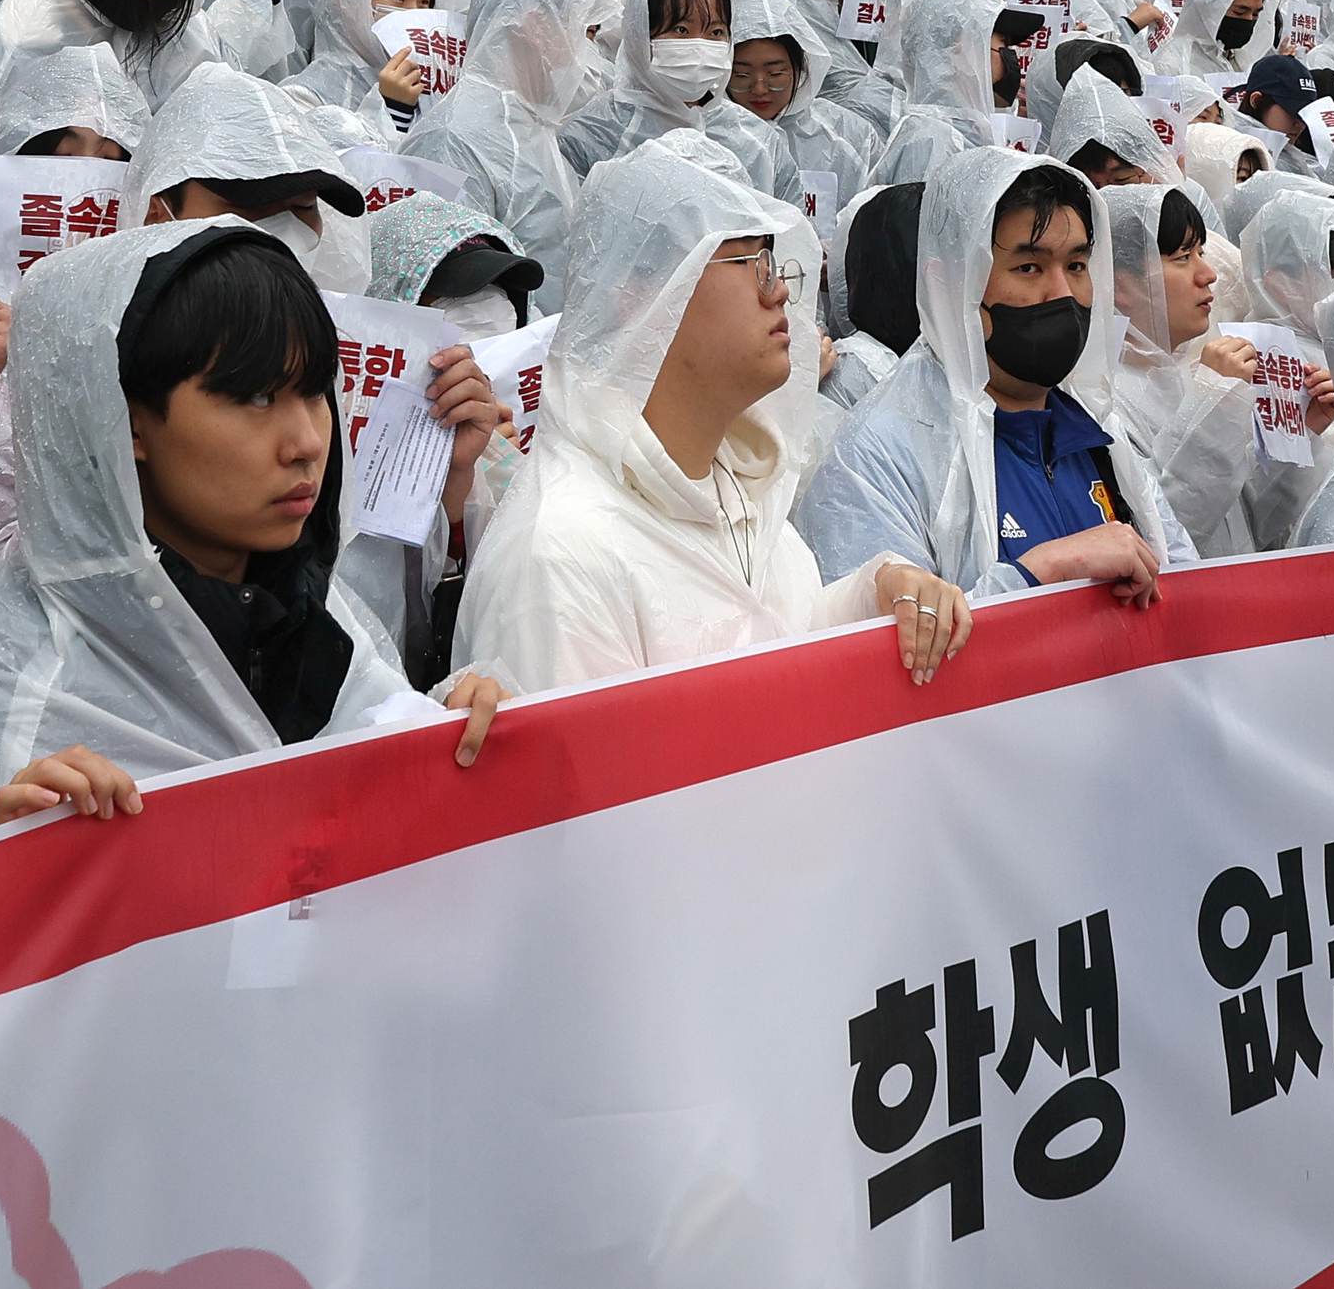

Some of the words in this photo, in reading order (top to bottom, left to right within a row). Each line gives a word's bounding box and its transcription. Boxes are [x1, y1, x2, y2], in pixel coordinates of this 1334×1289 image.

[1252, 350, 1304, 393] 졸속통합
[1254, 396, 1305, 438] 결사반대
[1000, 529, 1027, 539] adidas
[848, 909, 1126, 1242] 학생
